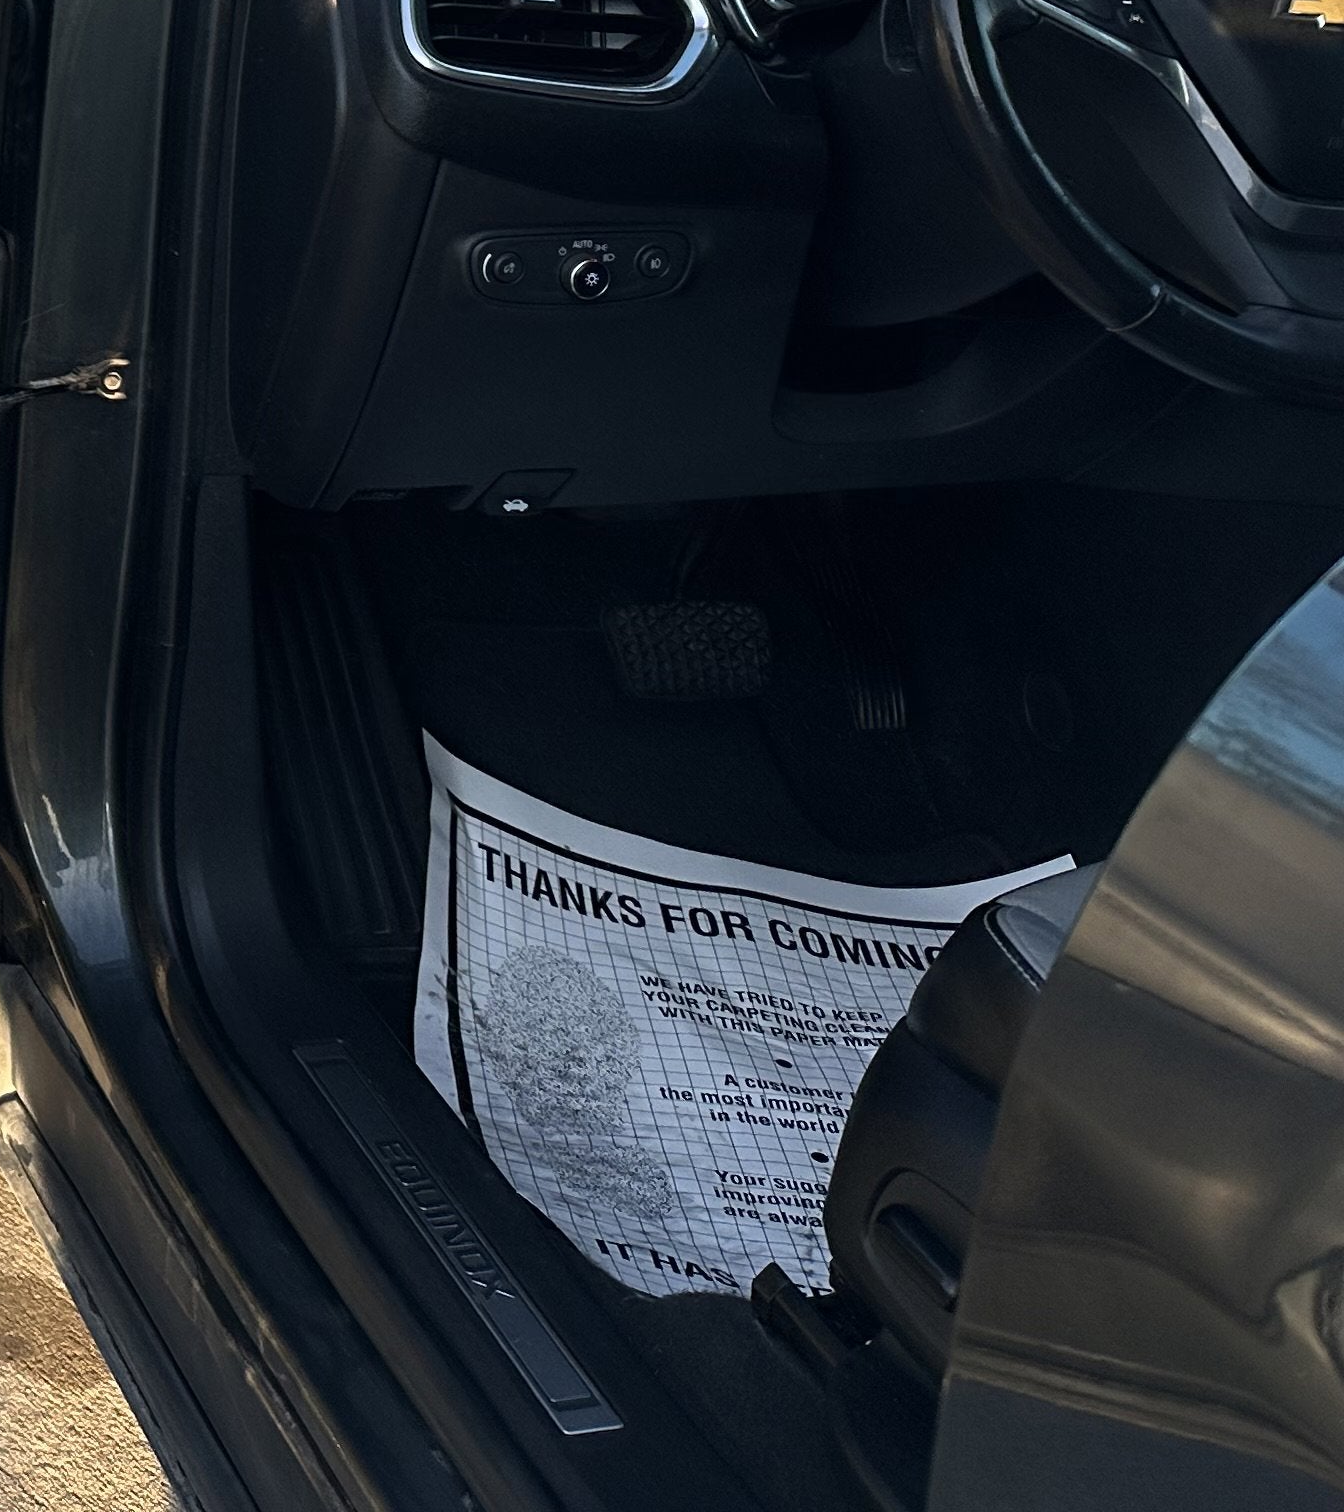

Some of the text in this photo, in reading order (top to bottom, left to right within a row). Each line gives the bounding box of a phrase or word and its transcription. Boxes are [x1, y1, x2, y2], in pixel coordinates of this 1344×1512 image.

[572, 239, 593, 250] AUTO
[478, 842, 646, 928] THANKS
[660, 903, 756, 942] FOR
[640, 975, 882, 1022] WE HAVE TRIED TO KEEP
[642, 990, 700, 1009] YOUR
[706, 999, 819, 1033] CARPETING
[658, 1006, 713, 1025] WITH
[717, 1016, 765, 1034] THIS
[769, 1027, 836, 1046] PAPER
[659, 1086, 693, 1101] the
[701, 1091, 753, 1107] most
[724, 1074, 739, 1087] A
[744, 1077, 843, 1101] customer
[709, 1108, 840, 1134] in the world
[715, 1169, 828, 1196] Your sugg
[723, 1205, 823, 1228] are alwa
[595, 1238, 740, 1289] IT HAS
